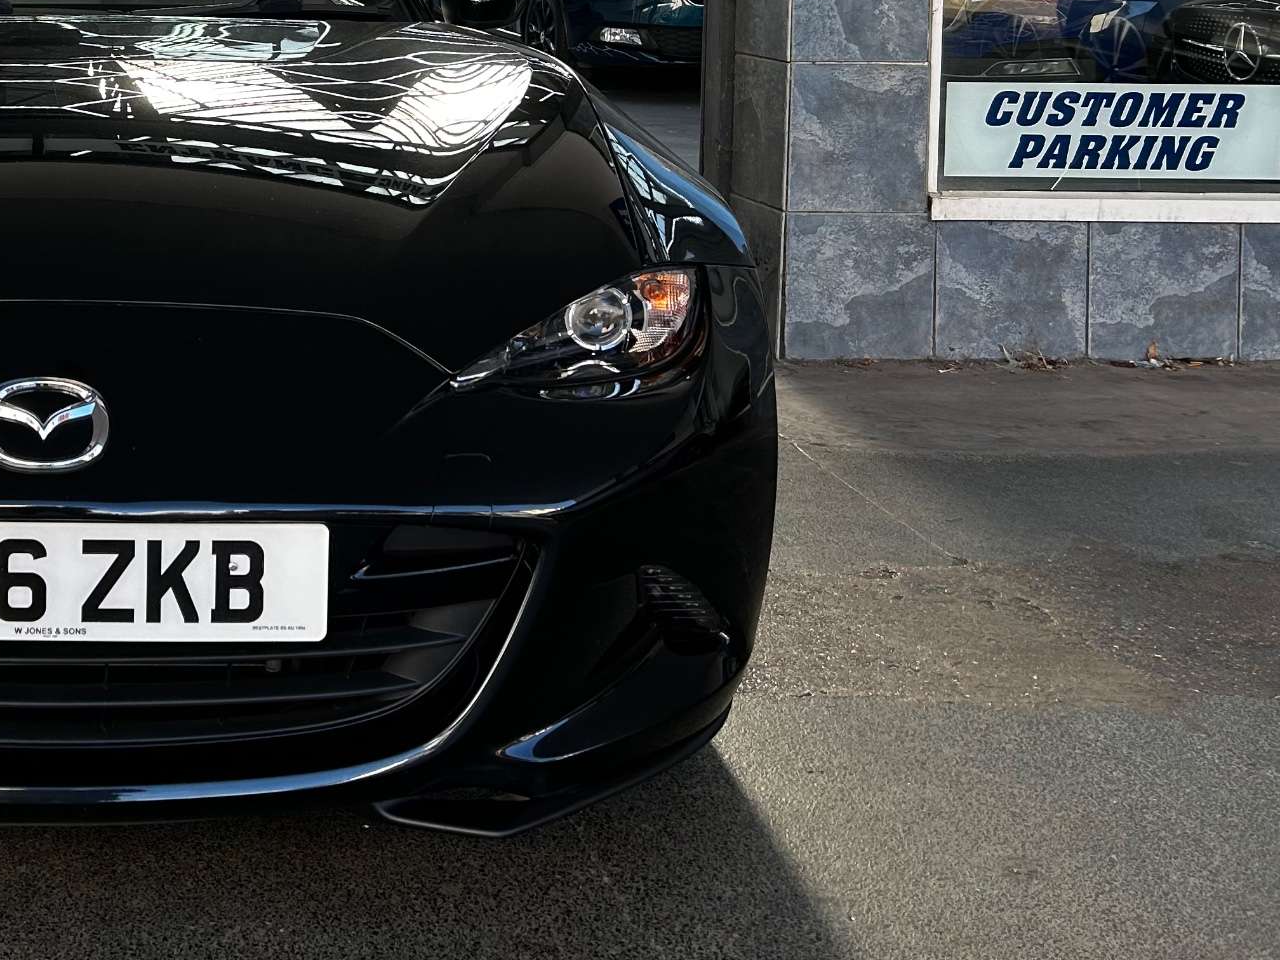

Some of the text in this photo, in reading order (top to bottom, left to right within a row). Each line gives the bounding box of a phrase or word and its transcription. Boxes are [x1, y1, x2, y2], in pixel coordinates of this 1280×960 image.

[985, 90, 1246, 129] CUSTOMER
[1008, 134, 1221, 172] PARKING
[80, 539, 264, 623] ZKB
[14, 627, 87, 635] W JONES & SONS
